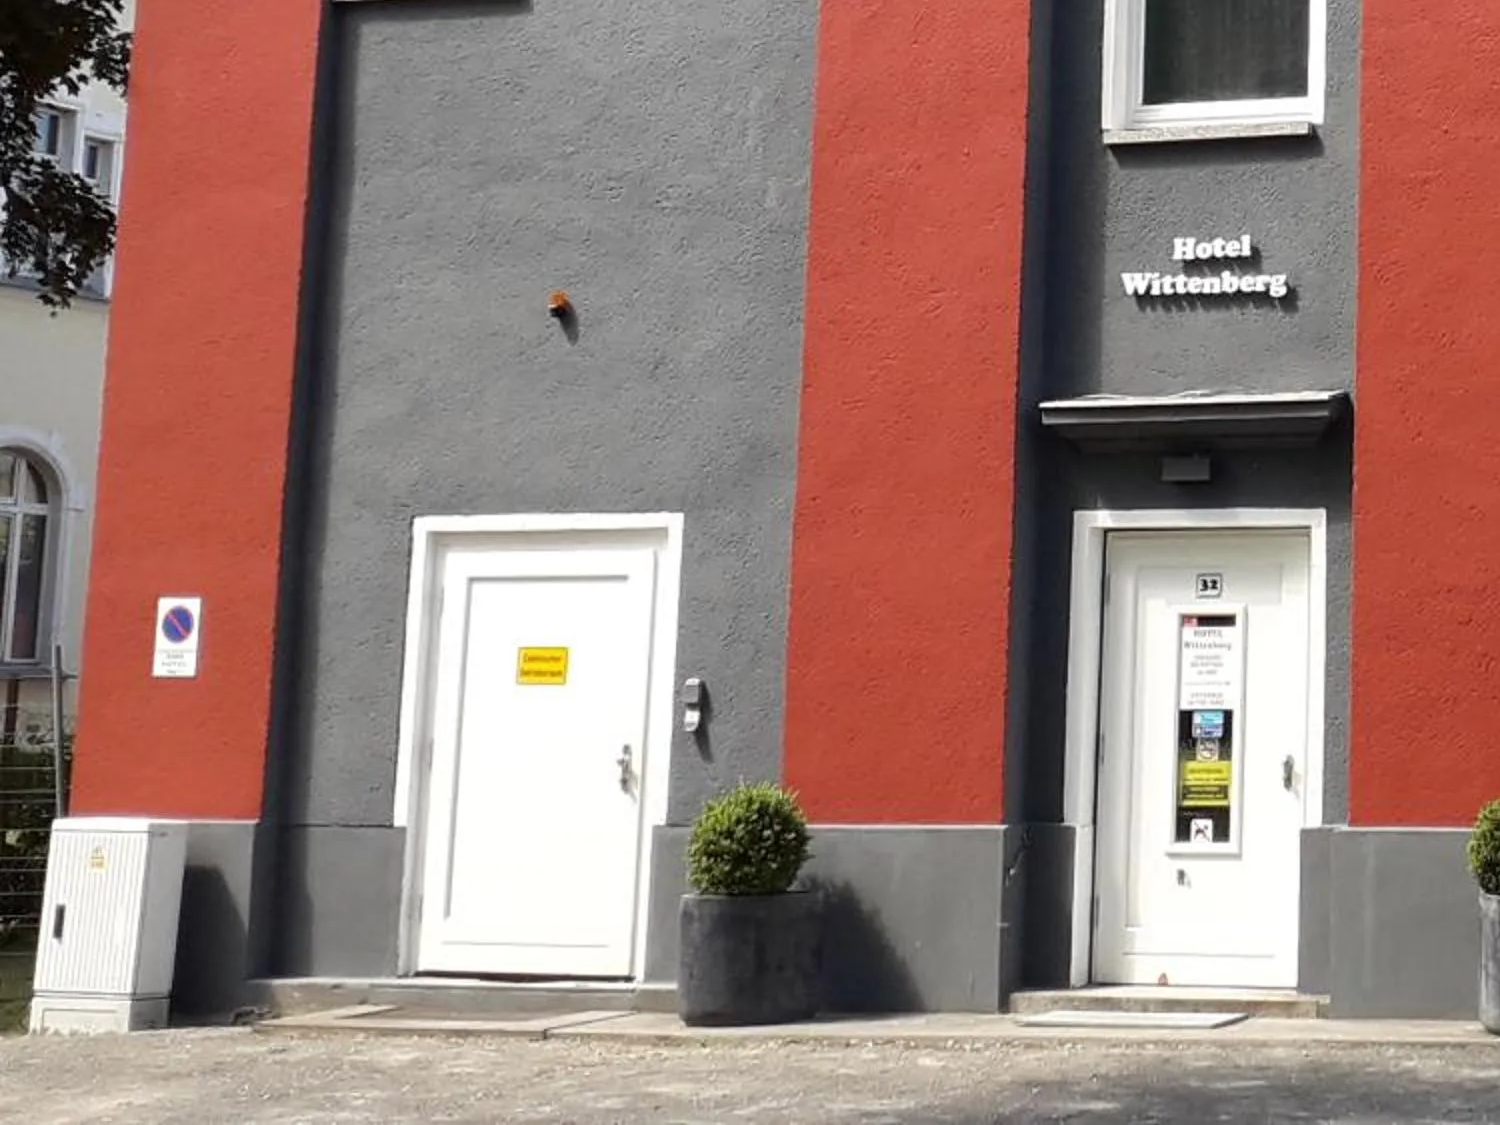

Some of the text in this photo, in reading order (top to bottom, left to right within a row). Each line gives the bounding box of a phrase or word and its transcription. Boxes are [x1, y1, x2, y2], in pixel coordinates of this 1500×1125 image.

[1172, 235, 1252, 260] Hotel
[1120, 271, 1287, 297] Wittenberg
[1199, 578, 1219, 592] 32
